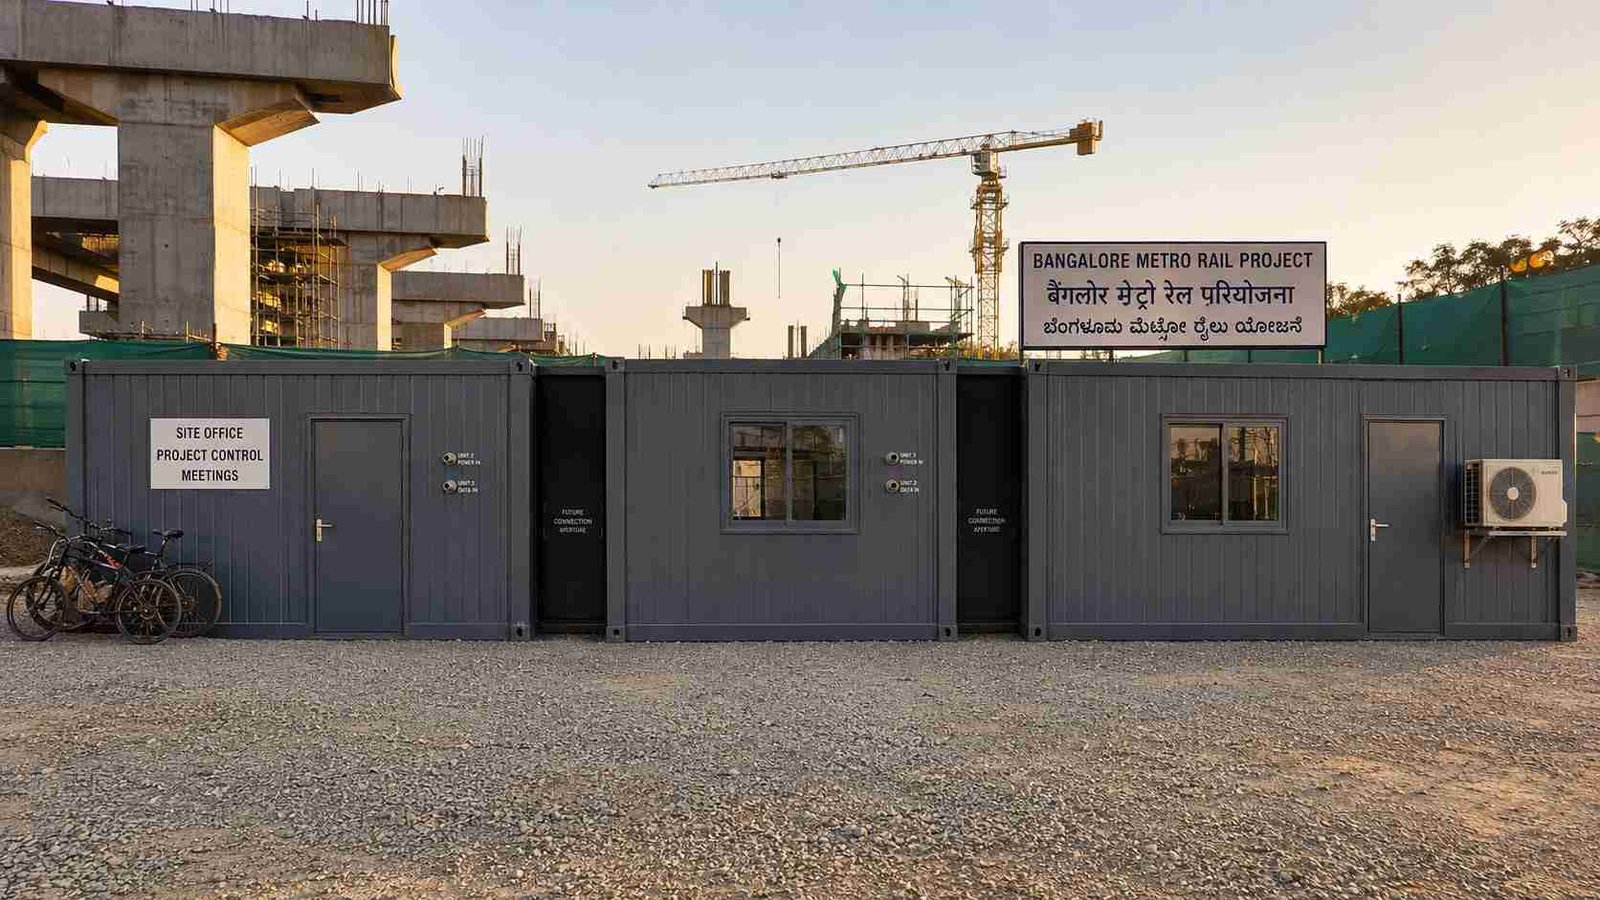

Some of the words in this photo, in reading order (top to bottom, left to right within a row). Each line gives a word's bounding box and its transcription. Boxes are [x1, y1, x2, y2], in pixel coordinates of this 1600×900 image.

[1033, 252, 1130, 269] BANGALORE
[1136, 252, 1191, 269] METRO
[1198, 252, 1233, 269] RAIL
[1240, 252, 1313, 269] PROJECT
[1046, 279, 1109, 305] बैंगलोर
[1163, 280, 1193, 305] रेल
[1235, 316, 1303, 334] ಯೋಜನೆ
[176, 427, 200, 439] SITE
[204, 427, 243, 439] OFFICE
[157, 449, 207, 461] PROJECT
[211, 449, 264, 461] CONTROL
[181, 469, 239, 481] MEETINGS
